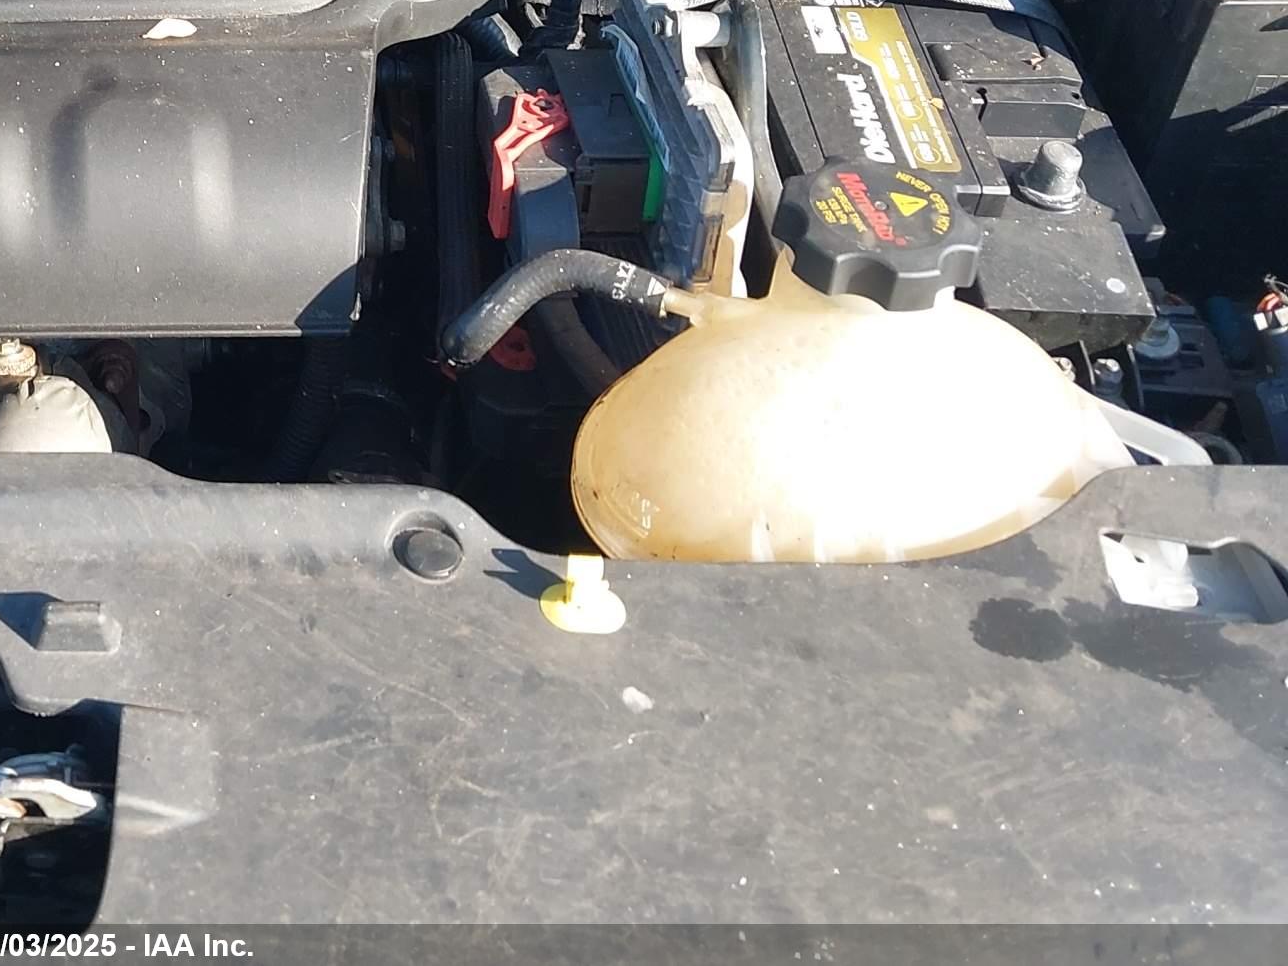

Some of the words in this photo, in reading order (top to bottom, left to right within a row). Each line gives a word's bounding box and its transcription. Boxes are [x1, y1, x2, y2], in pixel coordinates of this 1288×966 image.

[836, 72, 897, 164] DieHard
[896, 171, 933, 193] NEVER
[929, 192, 950, 215] OPEN
